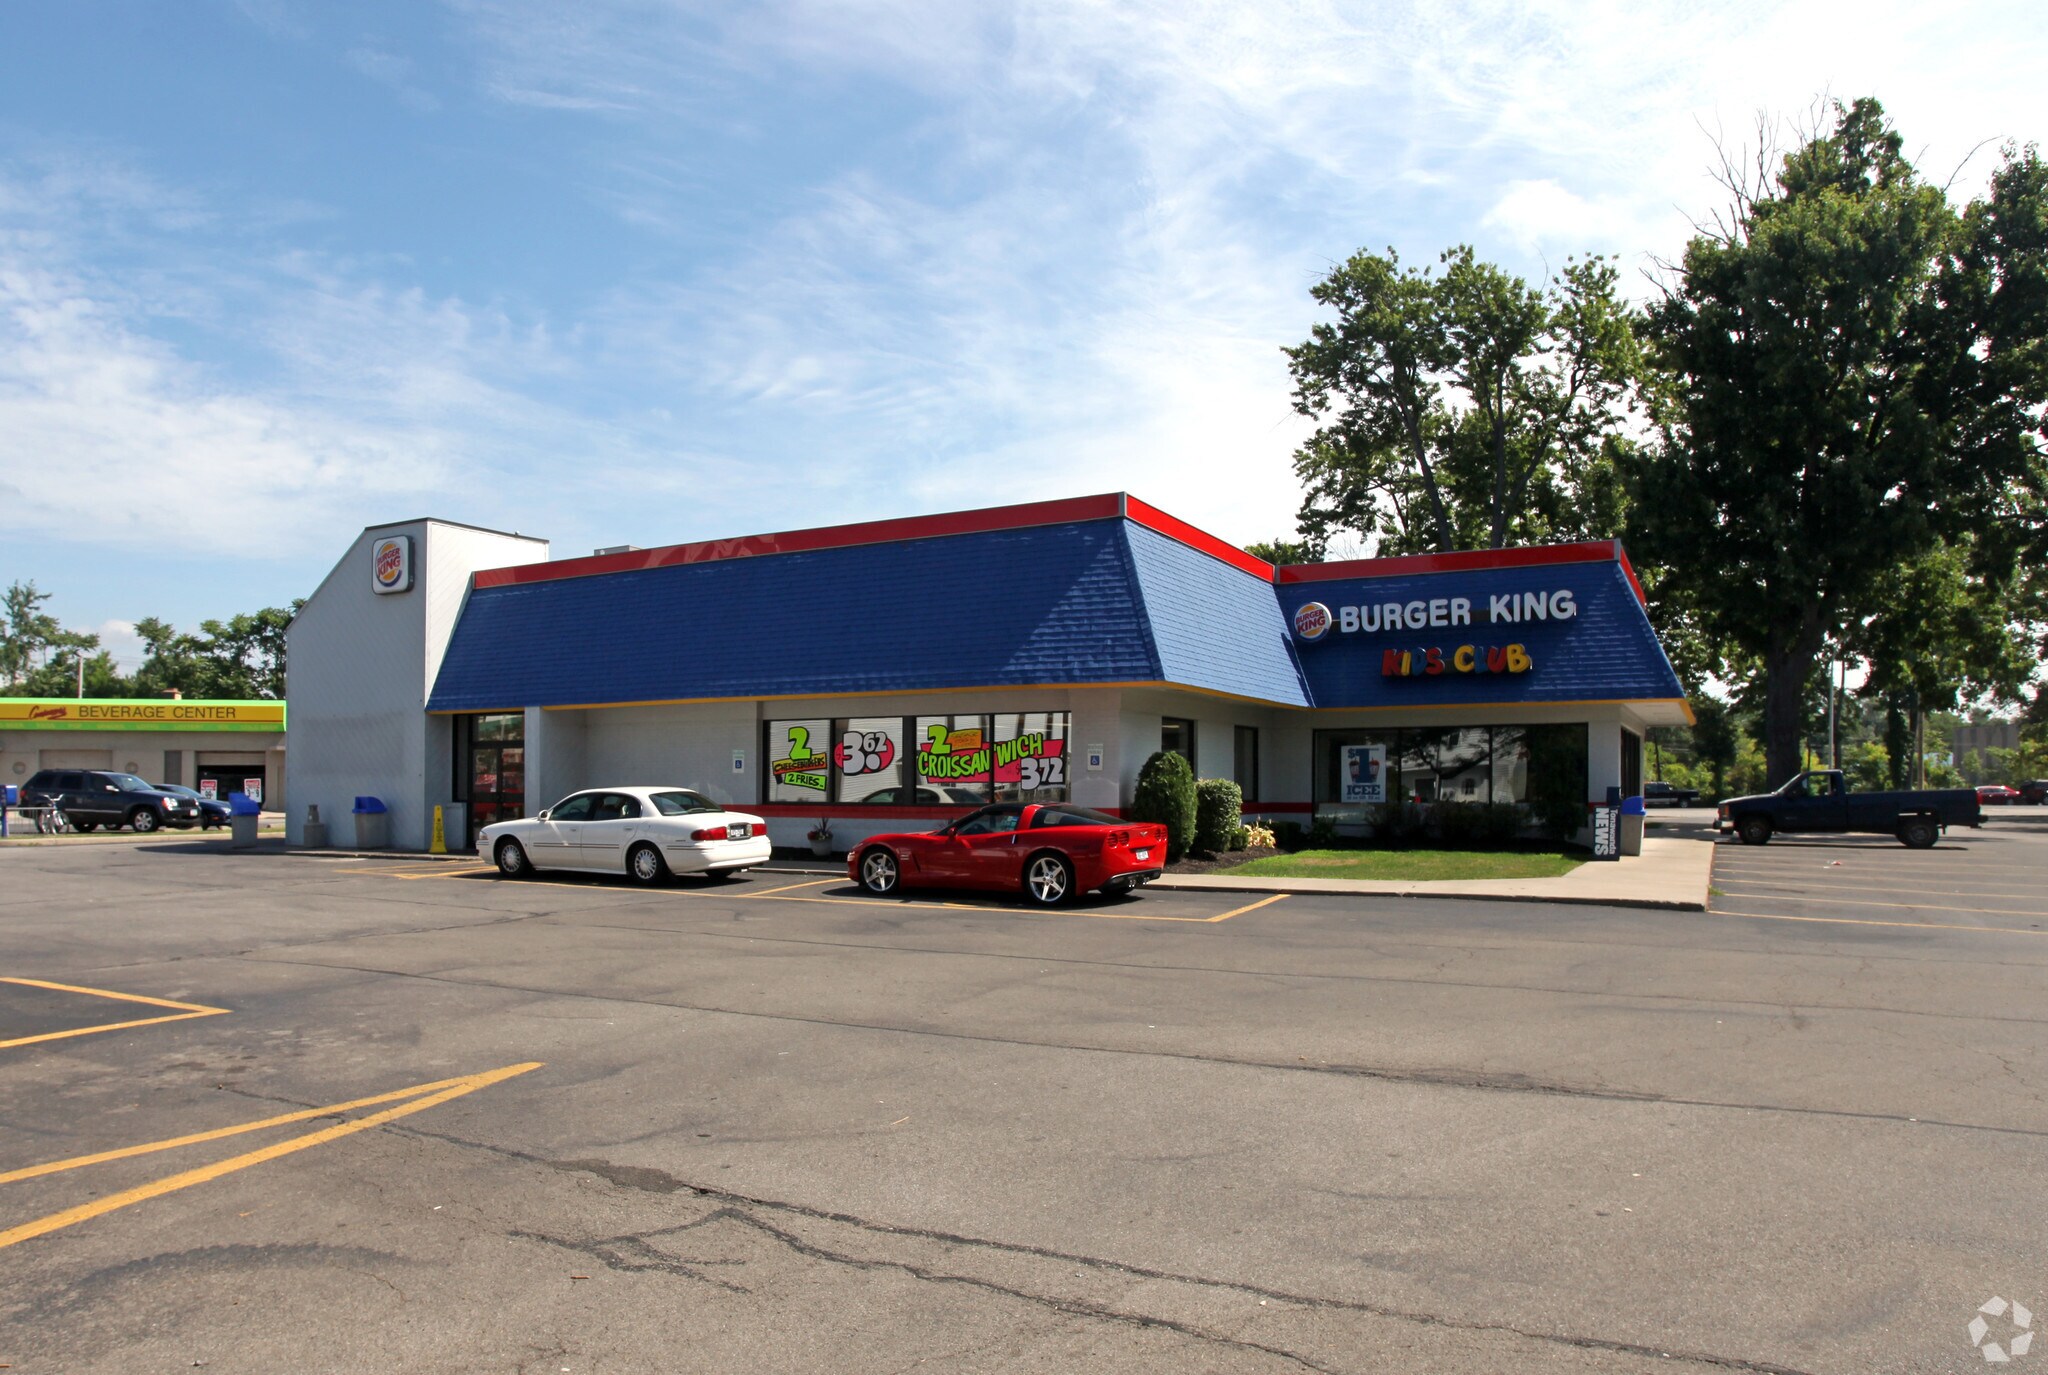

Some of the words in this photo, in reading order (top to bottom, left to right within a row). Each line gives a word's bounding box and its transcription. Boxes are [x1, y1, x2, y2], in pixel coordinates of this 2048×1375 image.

[377, 547, 400, 566] BURGER
[378, 556, 400, 577] KING
[1295, 609, 1324, 625] BURGER
[1339, 597, 1471, 633] BURGER
[1489, 589, 1576, 624] KING
[1297, 615, 1326, 634] KING
[1381, 646, 1444, 677] KIDS
[1453, 643, 1532, 675] CLUB
[79, 705, 165, 718] BEVERAGE
[173, 707, 236, 719] CENTER
[788, 726, 813, 761] 2
[927, 724, 952, 755] 2
[788, 773, 796, 783] 2
[1346, 784, 1381, 796] ICEE
[1594, 807, 1610, 856] NEWS
[1609, 809, 1618, 855] Tonawanda
